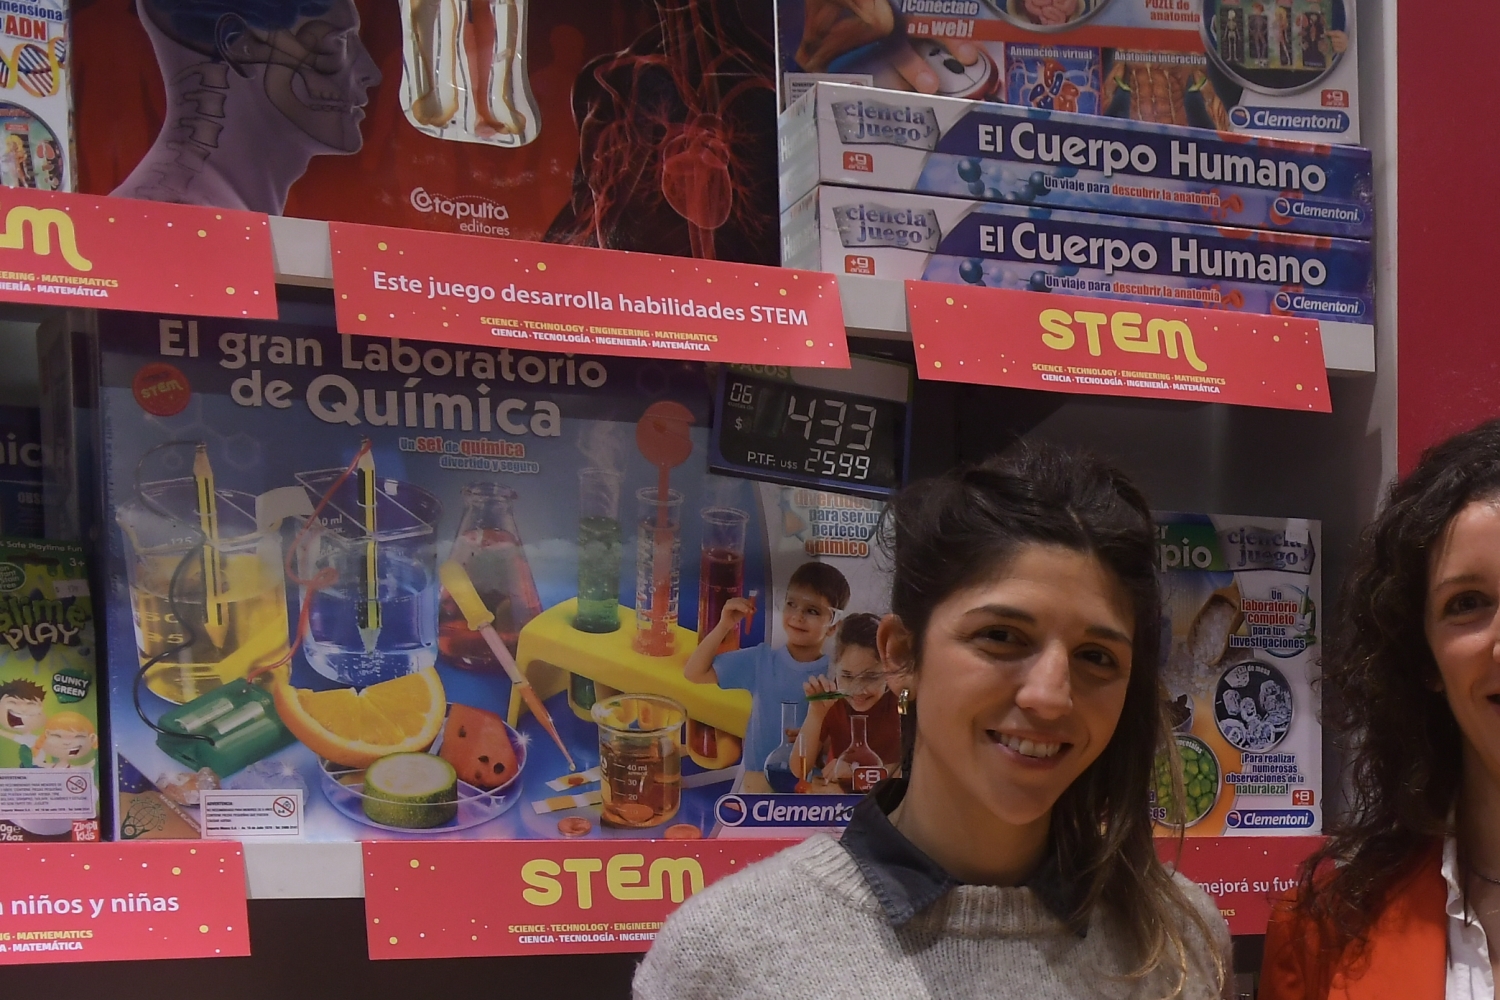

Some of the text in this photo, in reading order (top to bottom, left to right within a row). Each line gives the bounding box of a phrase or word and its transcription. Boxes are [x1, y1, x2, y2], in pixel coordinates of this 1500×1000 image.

[5, 15, 46, 41] ADN
[908, 19, 973, 38] a la web!
[1010, 46, 1092, 60] Animación virtual
[1114, 50, 1206, 65] Anatomía interactiva
[846, 101, 926, 124] ciencia
[1252, 110, 1342, 129] Clementoni
[856, 121, 919, 144] juego
[978, 123, 1326, 192] El Cuerpo Humano
[1044, 176, 1220, 207] Un viaje para descubrir la anatomía
[1292, 204, 1360, 222] Clementoni
[460, 221, 510, 236] editores
[979, 222, 1326, 286] El Cuerpo Humano
[42, 274, 118, 287] MATHEMATICS
[37, 284, 108, 297] MATEMÁTICA
[373, 272, 808, 326] Este juego desarrolla habilidades STEM
[481, 317, 718, 342] SCIENCE TECHNOLOGY ENGINEERING MATHEMATICS
[492, 328, 710, 351] CIENCIA TECNOLOGÍA INGENIERÍA MATEMÁTICA
[1041, 309, 1207, 372] STEM
[159, 319, 607, 388] El gran Laboratorio
[730, 383, 752, 404] 06
[231, 371, 562, 436] de Química
[788, 396, 877, 451] 433
[400, 436, 524, 457] Un set de química
[804, 449, 870, 480] 2599
[810, 508, 837, 522] para
[842, 509, 864, 522] ser
[812, 523, 867, 539] perfecto
[805, 539, 868, 556] químico
[1271, 590, 1282, 599] Un
[1241, 599, 1297, 612] laboratorio
[1248, 612, 1294, 625] completo
[1252, 625, 1285, 637] para tus
[1229, 636, 1305, 649] investigaciones
[54, 673, 88, 688] GUNKY
[54, 685, 85, 698] GREEN
[1242, 754, 1295, 764] ¡Para realizar
[1252, 764, 1297, 773] numerosas
[1225, 773, 1285, 784] observaciones
[1235, 783, 1288, 794] naturaleza!
[751, 800, 854, 822] Clemento
[1243, 813, 1310, 828] Clementoni
[521, 854, 704, 909] STEM
[1253, 880, 1269, 892] su
[12, 892, 179, 918] niños y niñas
[17, 930, 93, 939] MATHEMATICS
[12, 939, 83, 952] MATEMÁTICA
